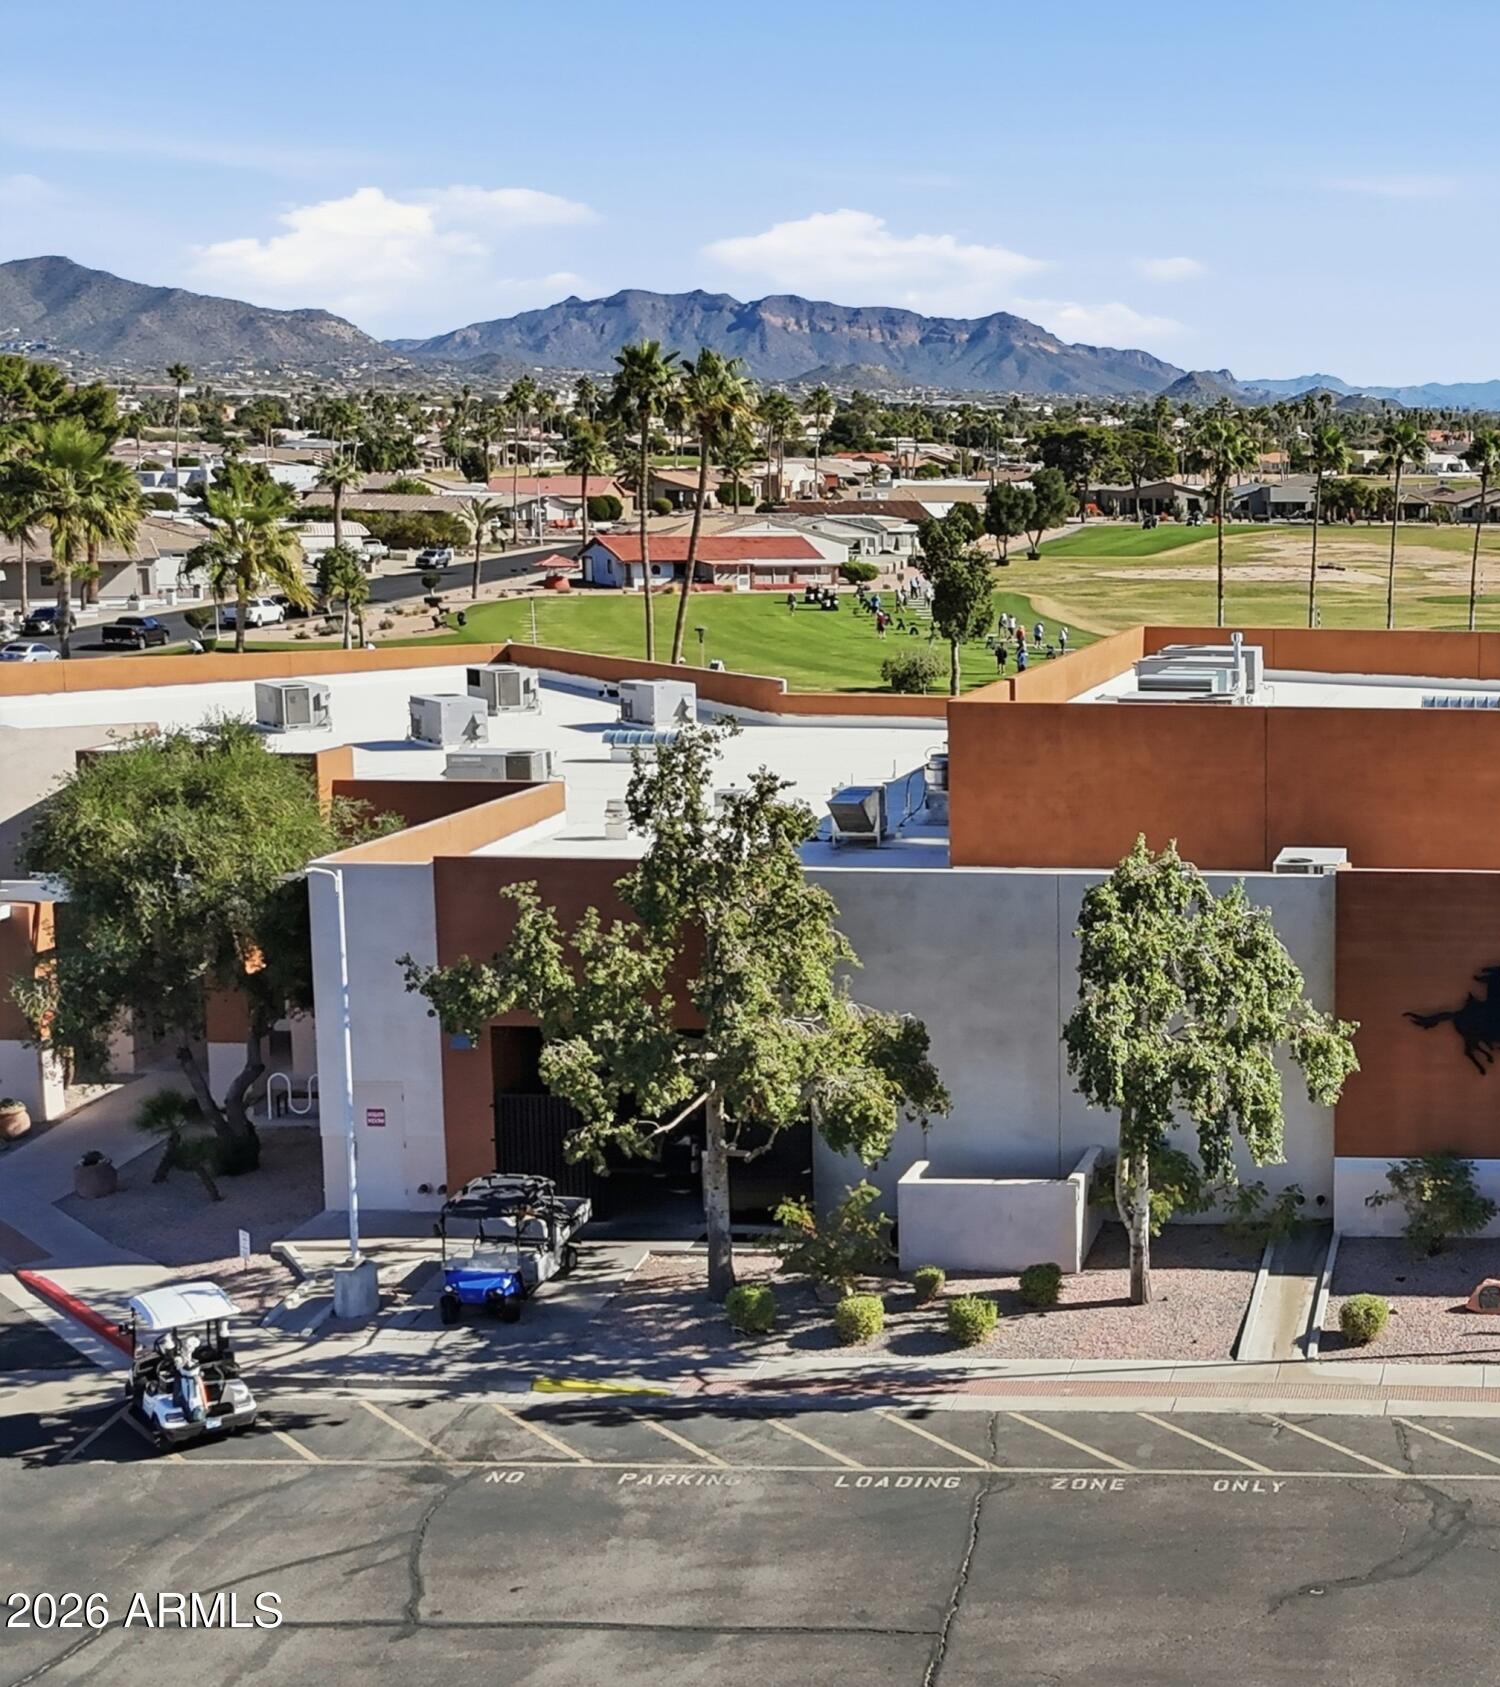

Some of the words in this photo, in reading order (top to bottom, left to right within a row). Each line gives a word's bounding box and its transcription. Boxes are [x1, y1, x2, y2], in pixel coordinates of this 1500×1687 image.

[485, 1471, 526, 1484] NO
[617, 1472, 741, 1486] PARKING
[834, 1475, 962, 1489] LOADING
[1051, 1478, 1127, 1491] ZONE
[1212, 1479, 1287, 1493] ONLY
